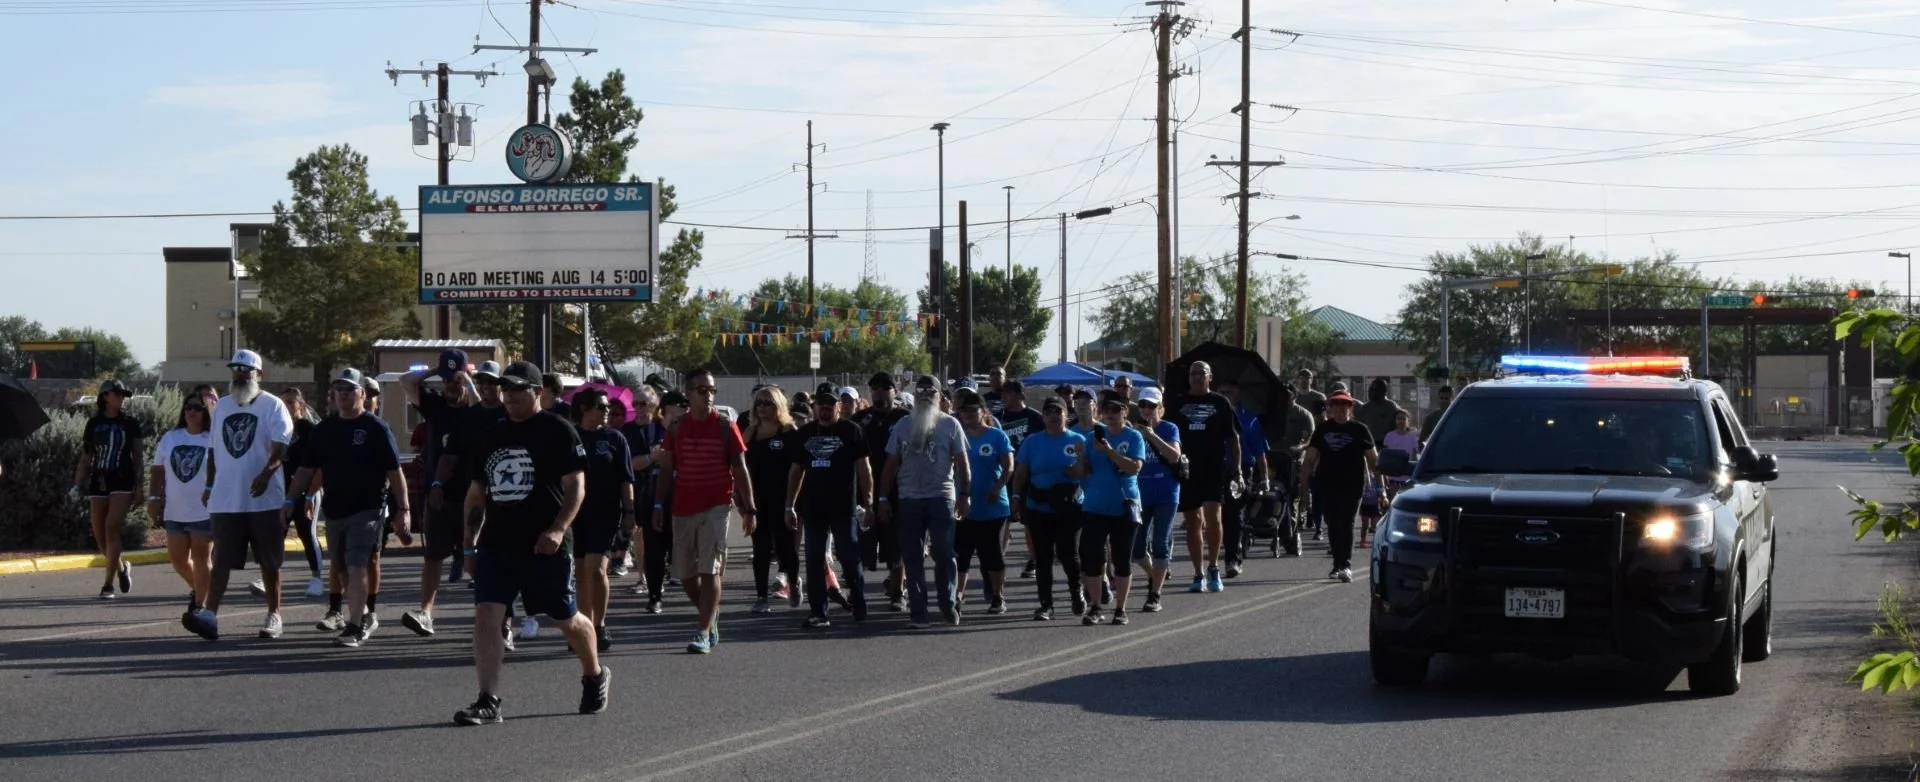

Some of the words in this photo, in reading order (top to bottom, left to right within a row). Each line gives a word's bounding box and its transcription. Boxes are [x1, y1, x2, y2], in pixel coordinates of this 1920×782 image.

[428, 190, 515, 203] ALFONSO
[519, 189, 608, 202] BORREGO
[613, 187, 643, 201] SR.
[475, 204, 598, 212] ELEMENTARY
[424, 272, 477, 287] BOARD
[483, 271, 544, 286] MEETING
[551, 270, 580, 285] AUG
[590, 270, 605, 285] 14
[613, 269, 648, 284] 5:00
[440, 290, 518, 298] COMMITTED
[521, 289, 540, 297] TO
[543, 288, 631, 297] EXCELLENCE
